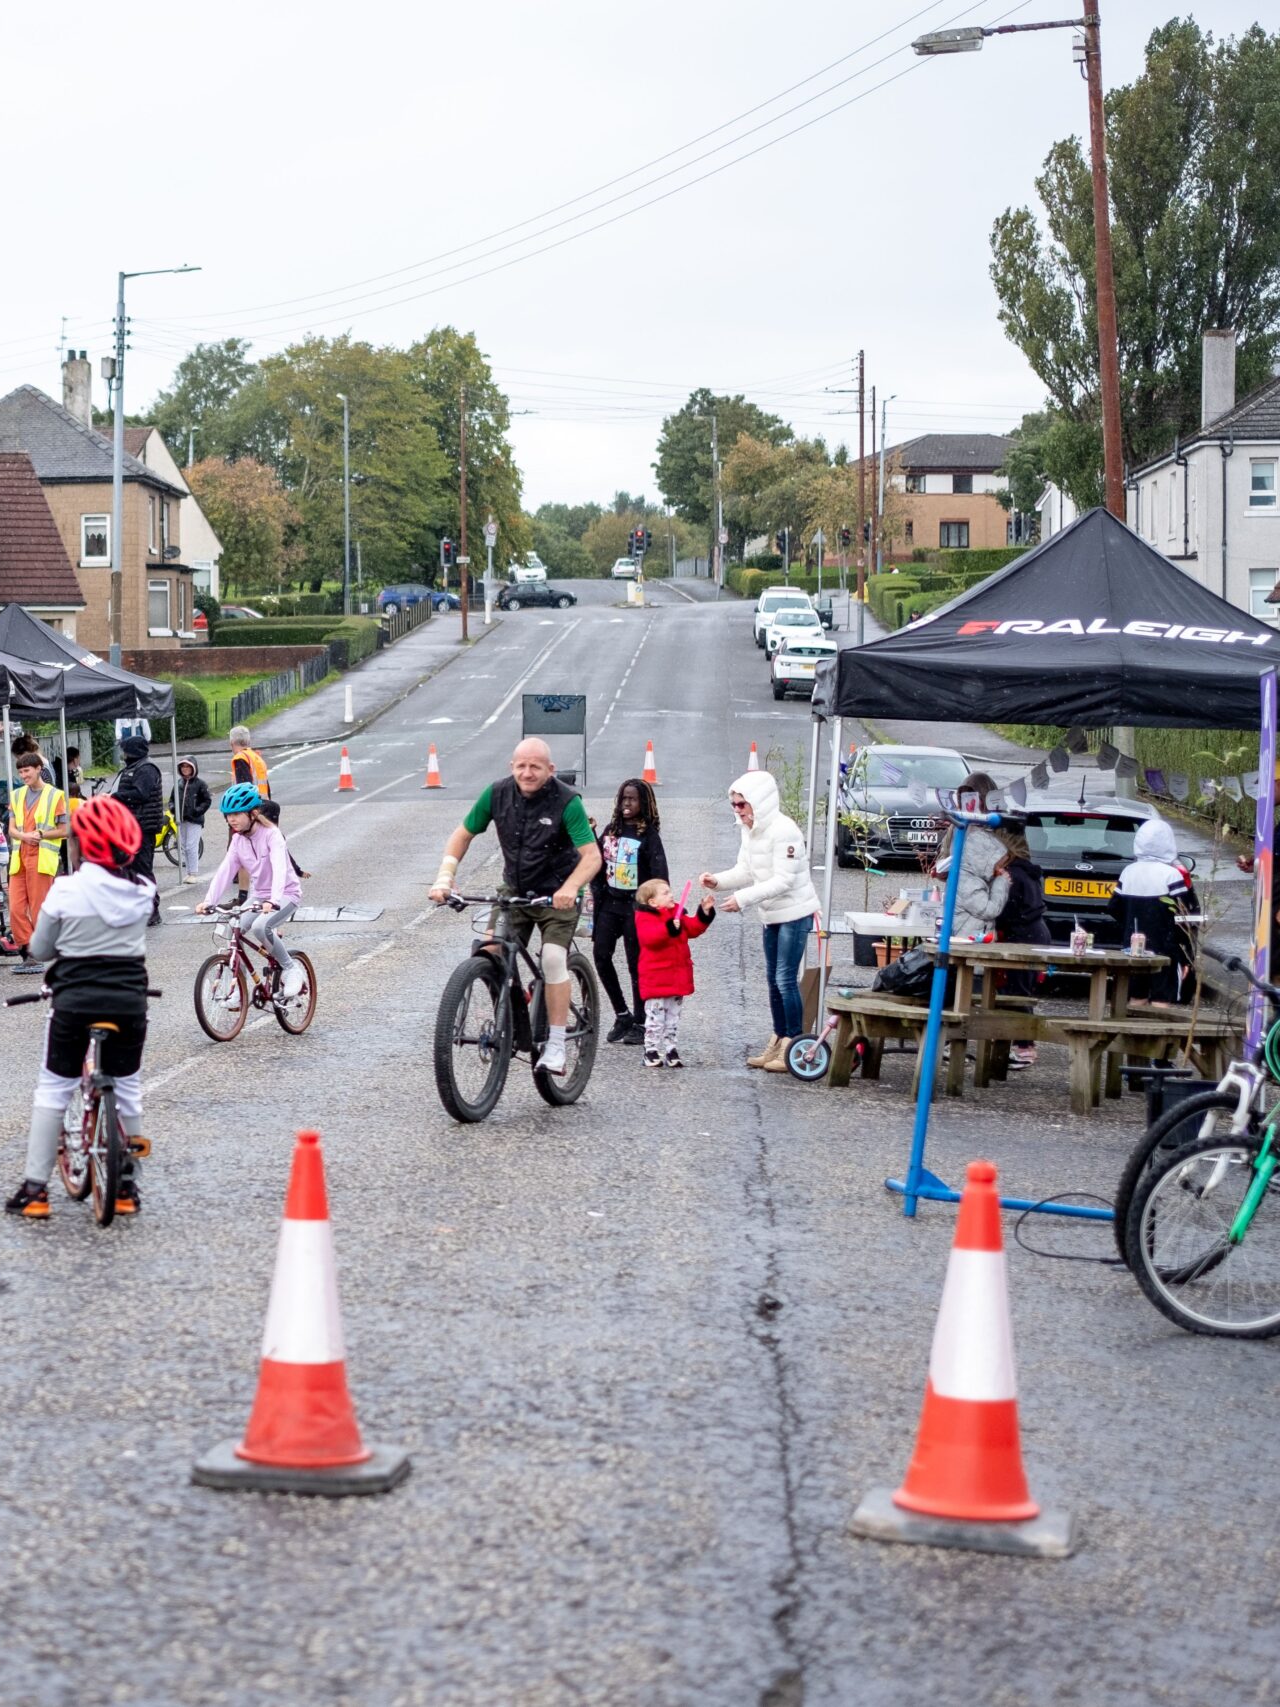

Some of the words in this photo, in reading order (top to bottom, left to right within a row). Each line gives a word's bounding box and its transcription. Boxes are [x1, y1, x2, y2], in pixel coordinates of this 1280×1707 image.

[993, 618, 1272, 646] RALEIGH
[1054, 880, 1083, 893] SJ18
[1087, 882, 1115, 895] LTK
